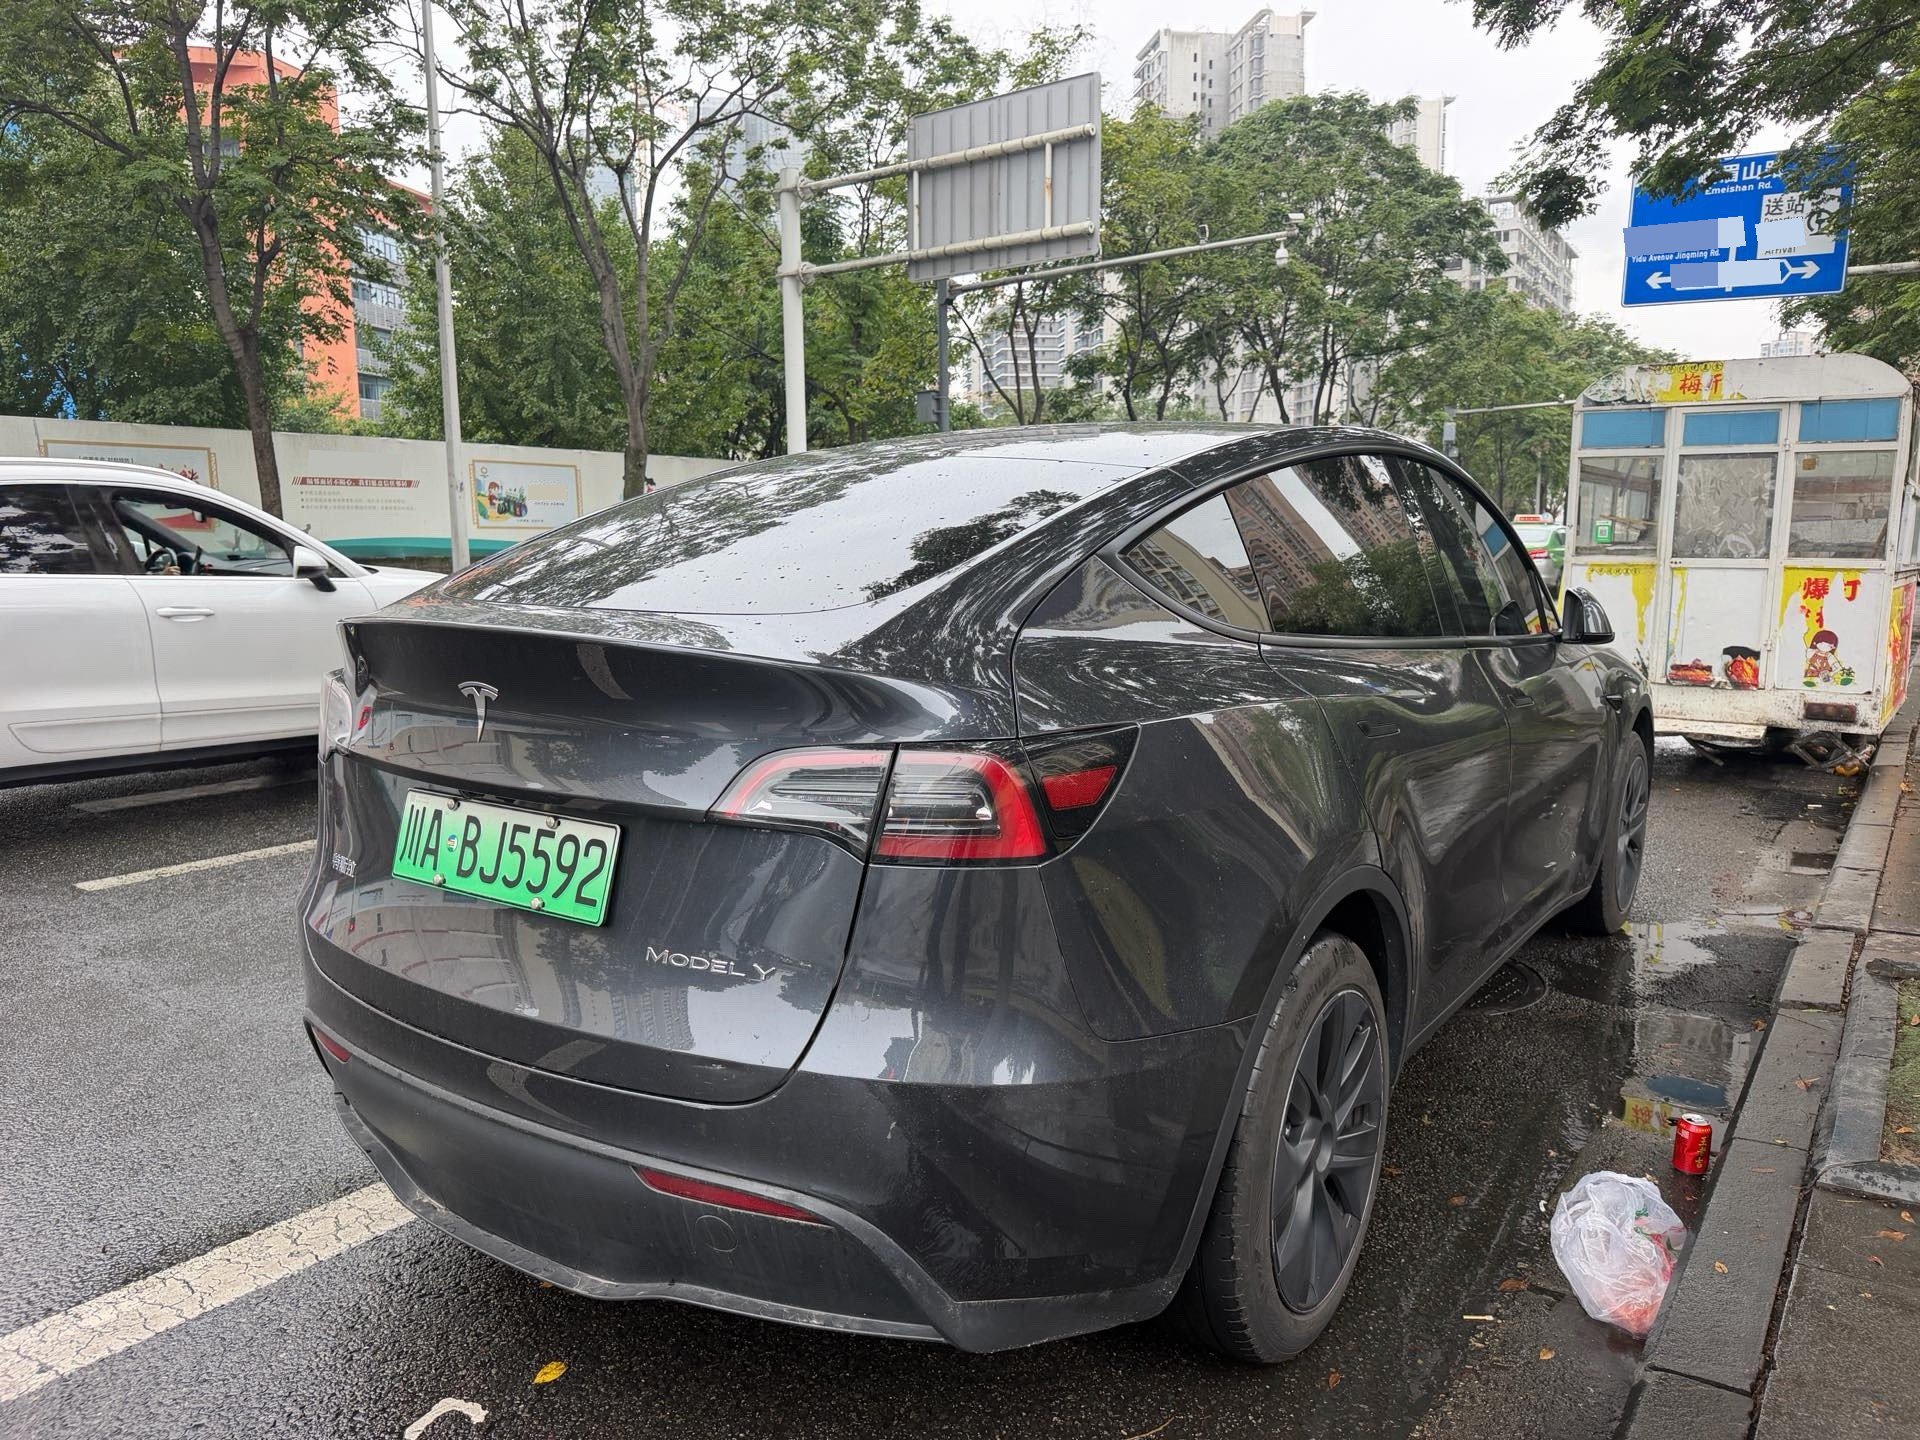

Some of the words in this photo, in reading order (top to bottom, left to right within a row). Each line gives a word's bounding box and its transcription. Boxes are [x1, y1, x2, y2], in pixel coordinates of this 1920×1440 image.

[1705, 184, 1754, 195] Emeishan
[1758, 181, 1773, 190] Rd.
[1764, 196, 1805, 216] 送站
[1632, 255, 1647, 263] Yidu
[1648, 253, 1673, 262] Avenue
[1675, 250, 1708, 260] Jingming
[1709, 248, 1721, 257] Rd.
[645, 946, 746, 977] MODEL
[752, 963, 776, 980] Y
